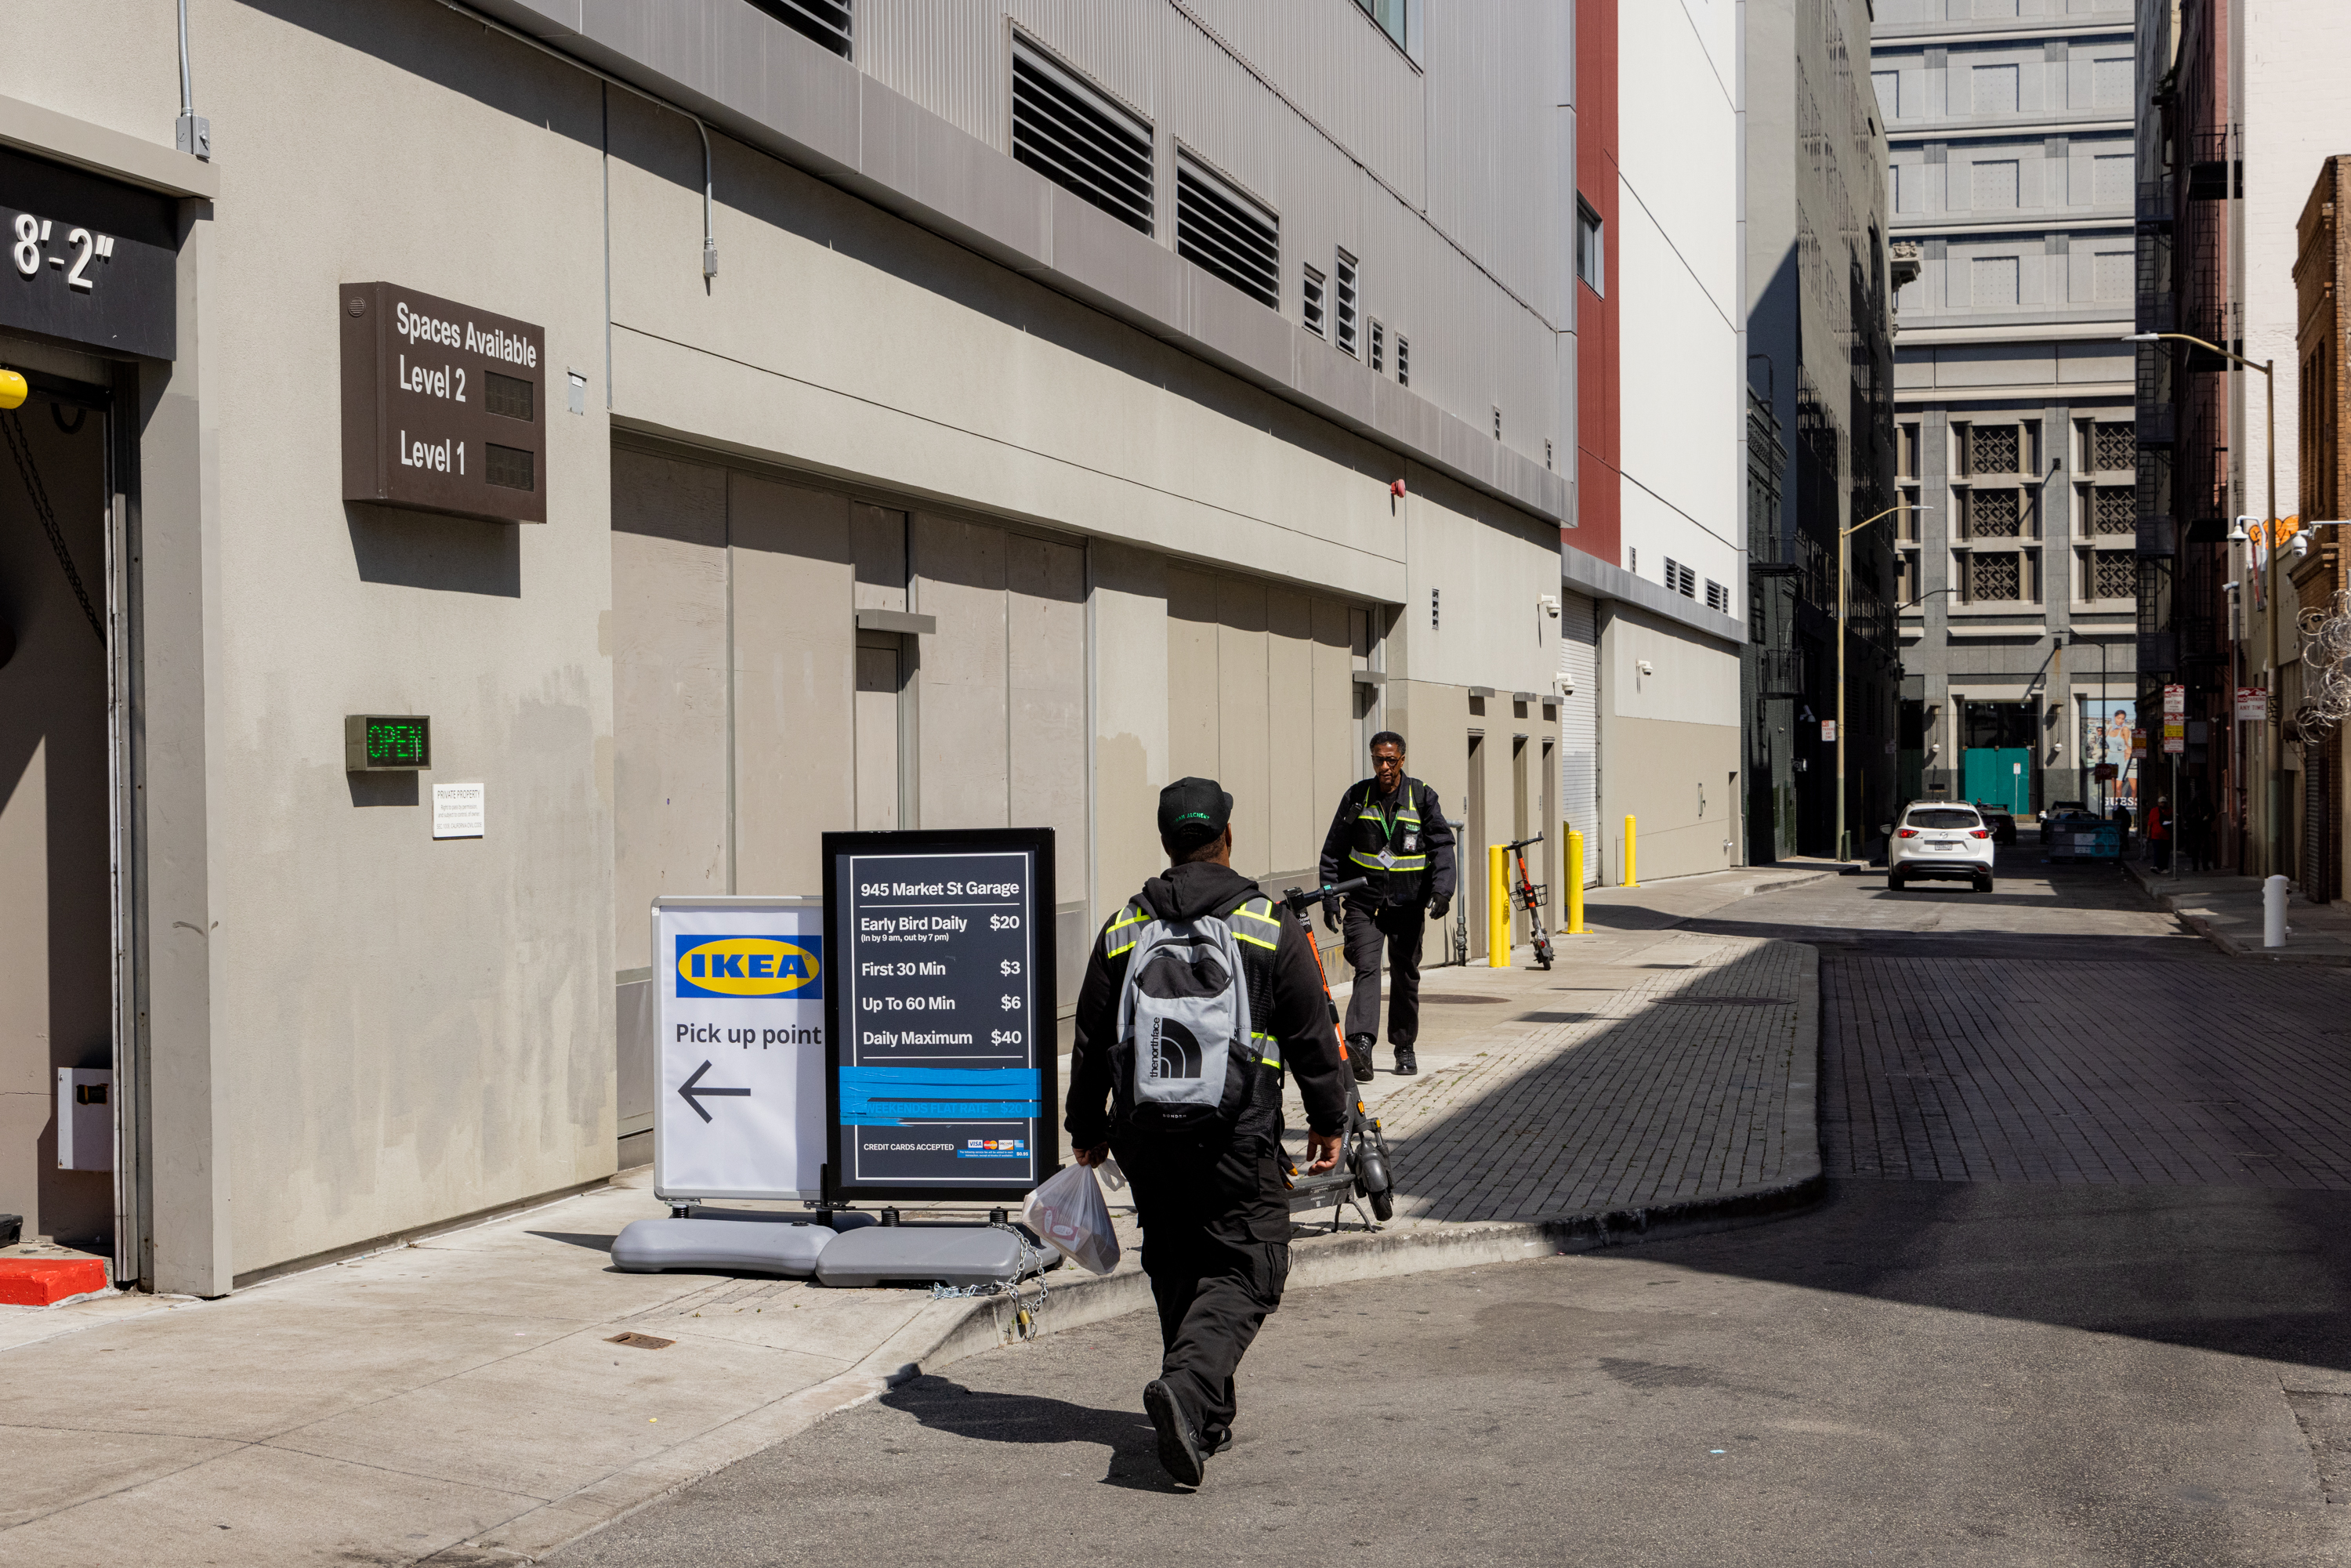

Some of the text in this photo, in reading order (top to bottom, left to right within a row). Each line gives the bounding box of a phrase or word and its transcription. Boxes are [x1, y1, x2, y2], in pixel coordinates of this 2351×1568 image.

[14, 214, 114, 288] 8'-2"
[397, 302, 537, 368] Spaces Available
[400, 353, 466, 403] Level 2
[400, 429, 465, 476] Level 1
[368, 726, 422, 758] OPEN
[437, 789, 480, 799] PRIVATE PROPERTY
[860, 881, 1020, 897] 945 Market St Garage
[861, 914, 1020, 933] Early Bird Daily $20
[861, 934, 870, 943] (In
[871, 934, 881, 943] by
[934, 933, 949, 942] pm)
[691, 954, 810, 979] IKEA
[862, 959, 1020, 976] First 30 Min $3
[862, 994, 1021, 1013] Up To 60 Min $6
[676, 1023, 822, 1050] Pick up point
[863, 1028, 1022, 1048] Daily Maximum $40
[1150, 1017, 1160, 1078] thenorthface
[866, 1101, 1023, 1114] WEEKENDS FLAT RATE $20
